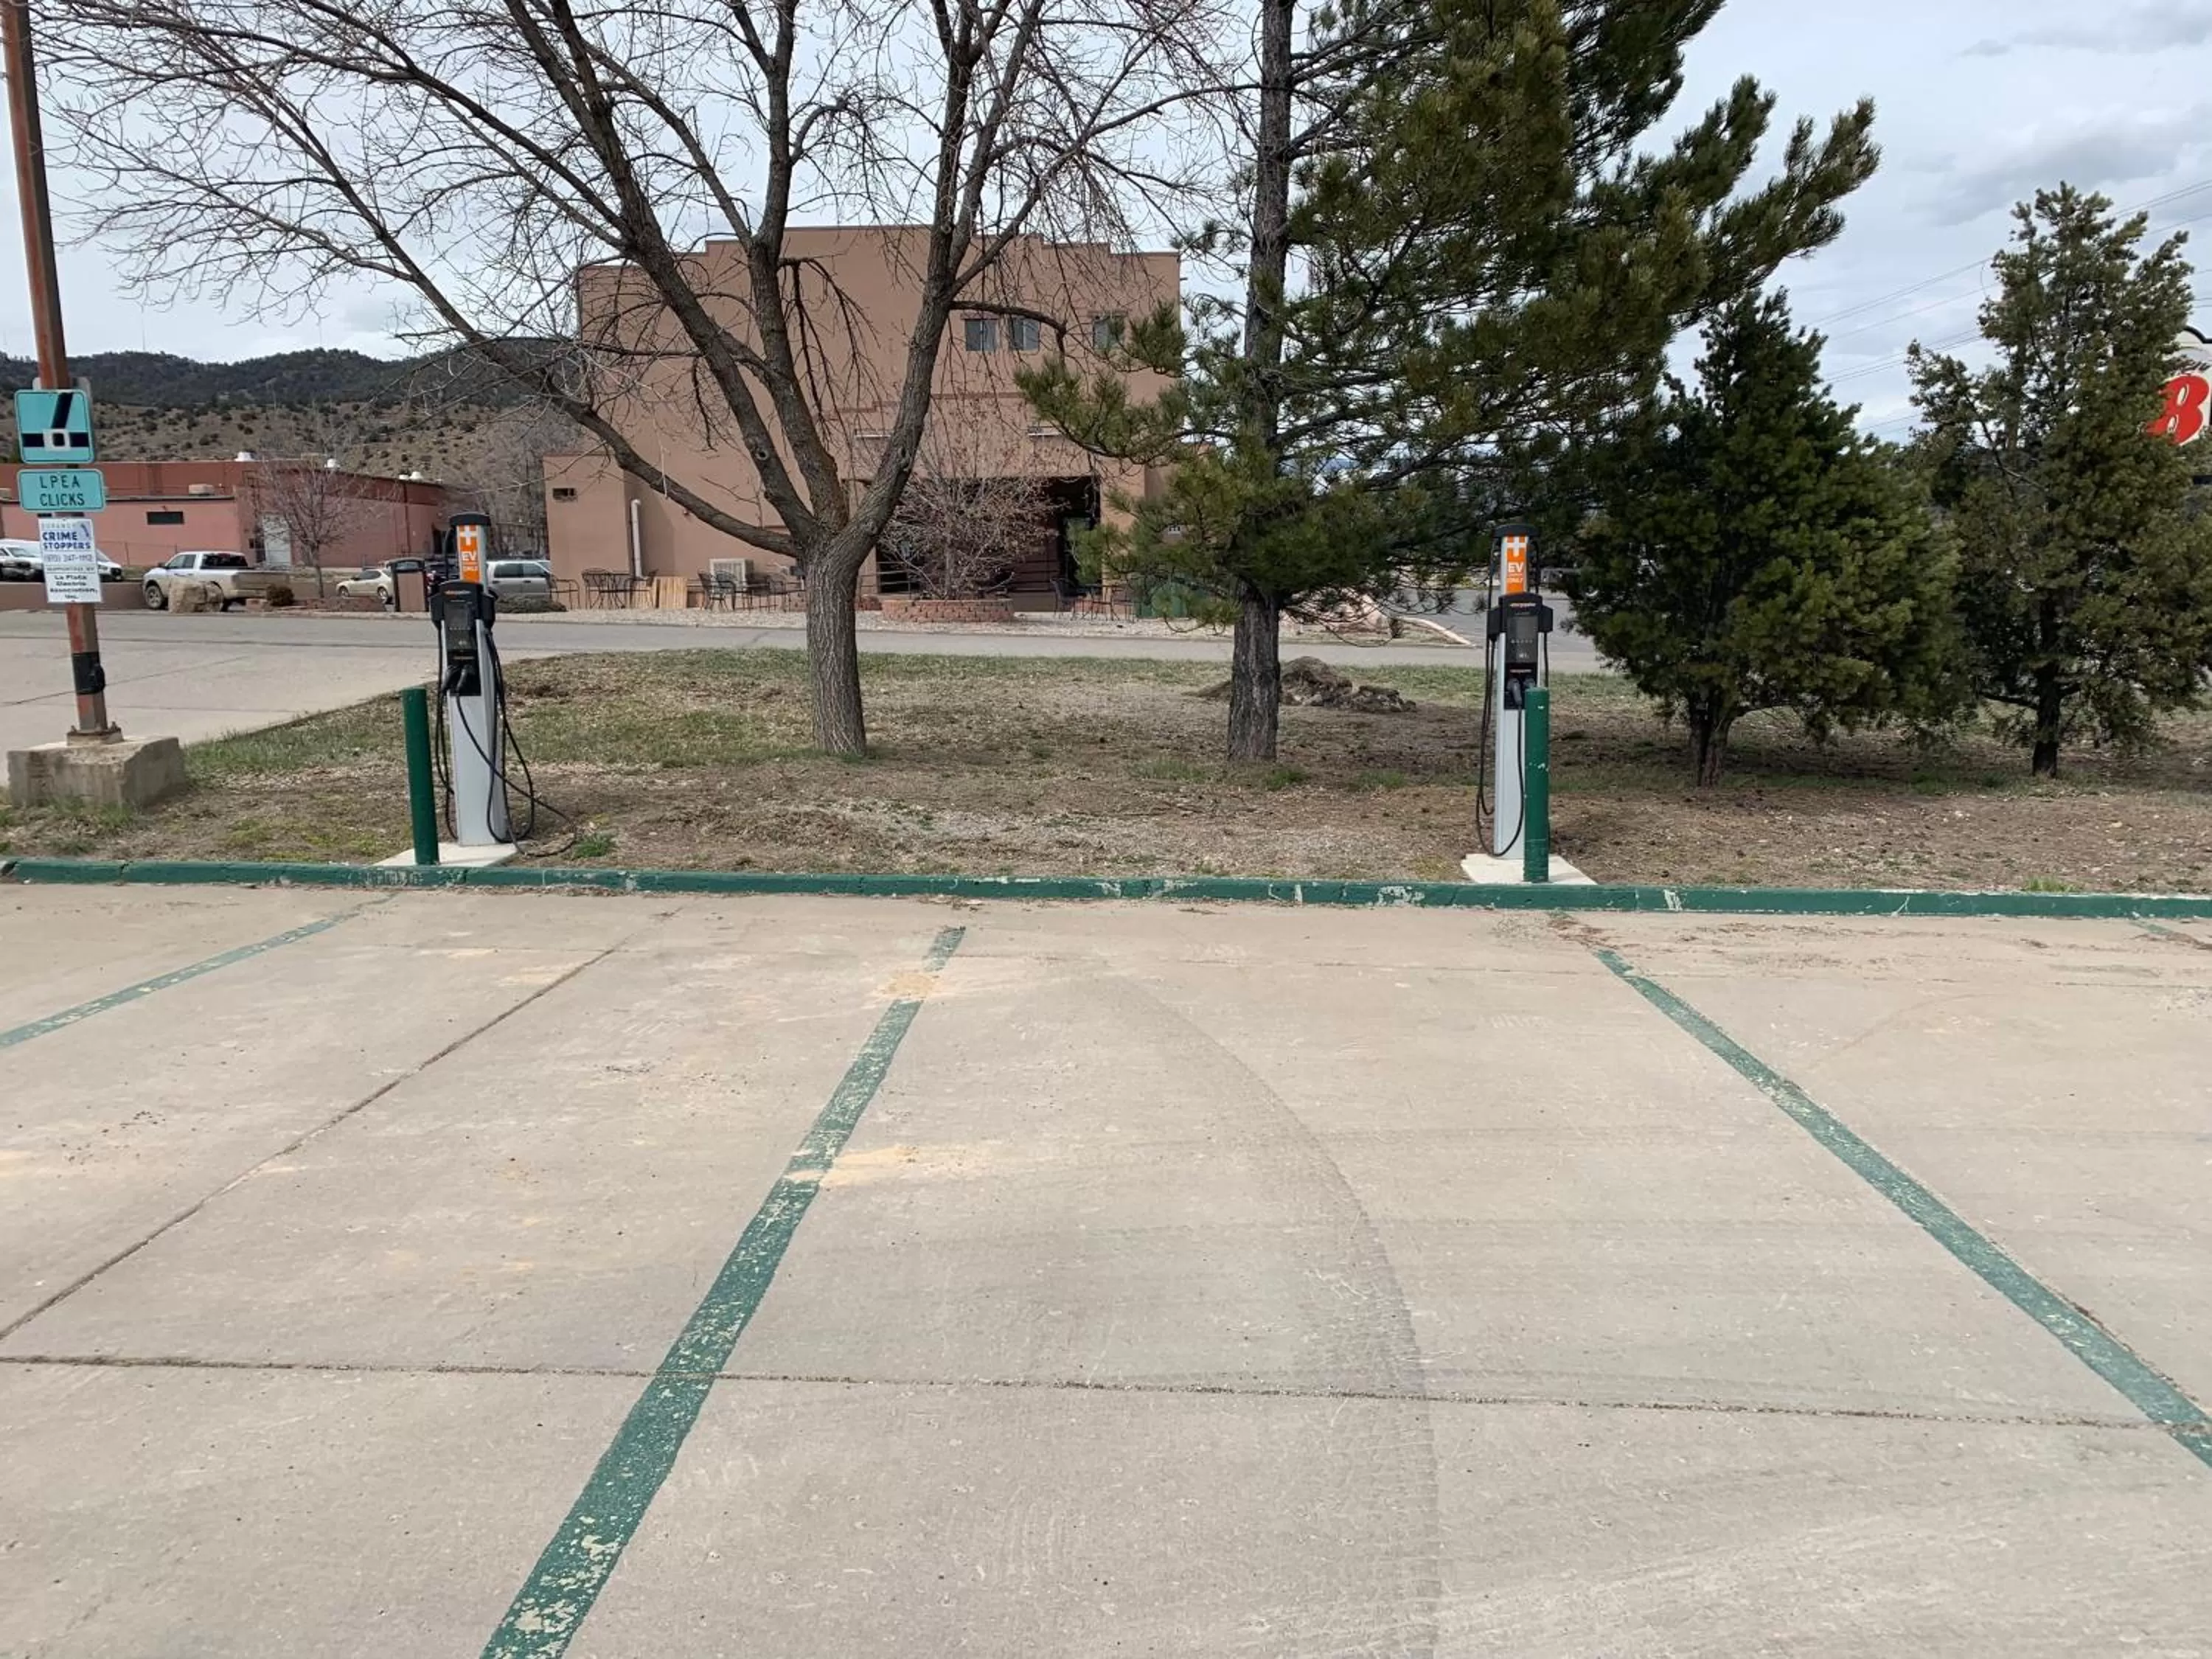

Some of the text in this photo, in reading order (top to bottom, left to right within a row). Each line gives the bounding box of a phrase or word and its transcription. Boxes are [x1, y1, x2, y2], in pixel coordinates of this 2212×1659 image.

[39, 475, 81, 488] LPEA
[40, 493, 85, 507] CLICKS
[42, 532, 77, 541] CRIME
[43, 542, 91, 550] STOPPERS
[462, 551, 477, 561] EV
[1508, 561, 1524, 573] EV
